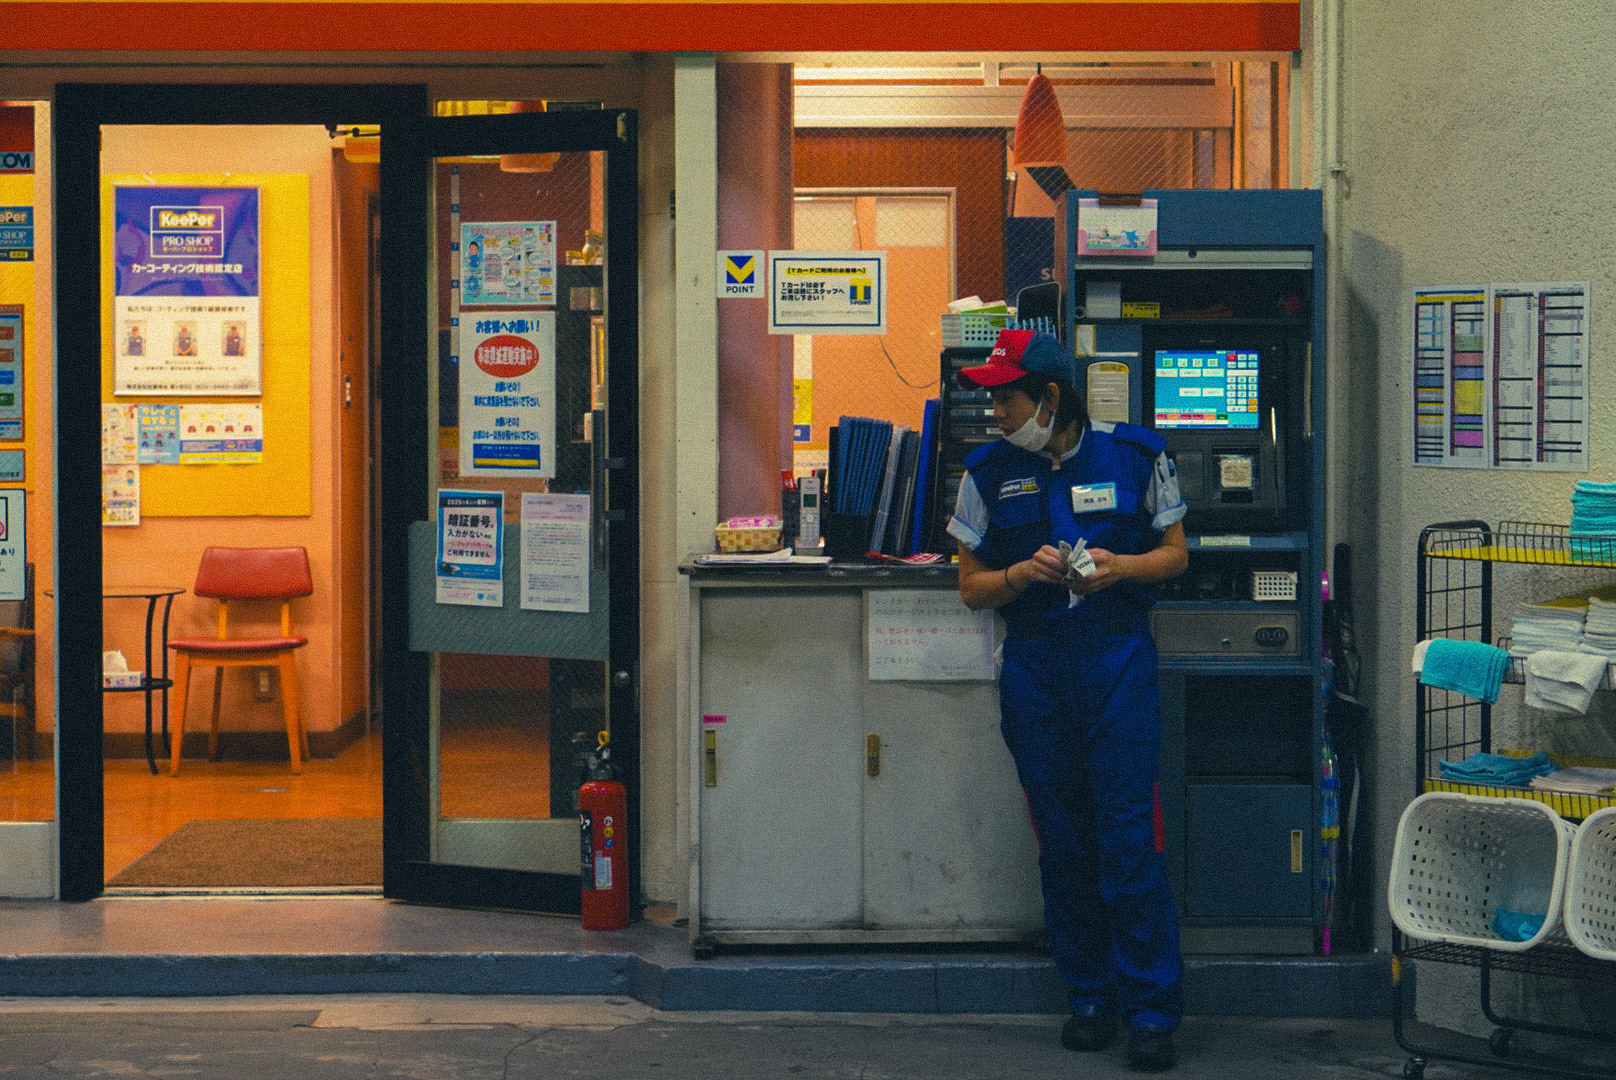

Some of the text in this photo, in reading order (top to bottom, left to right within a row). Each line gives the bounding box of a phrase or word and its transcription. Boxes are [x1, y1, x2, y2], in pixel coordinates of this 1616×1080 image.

[160, 212, 214, 227] KeePer
[163, 236, 213, 245] PRO SHOP
[726, 286, 755, 294] POINT
